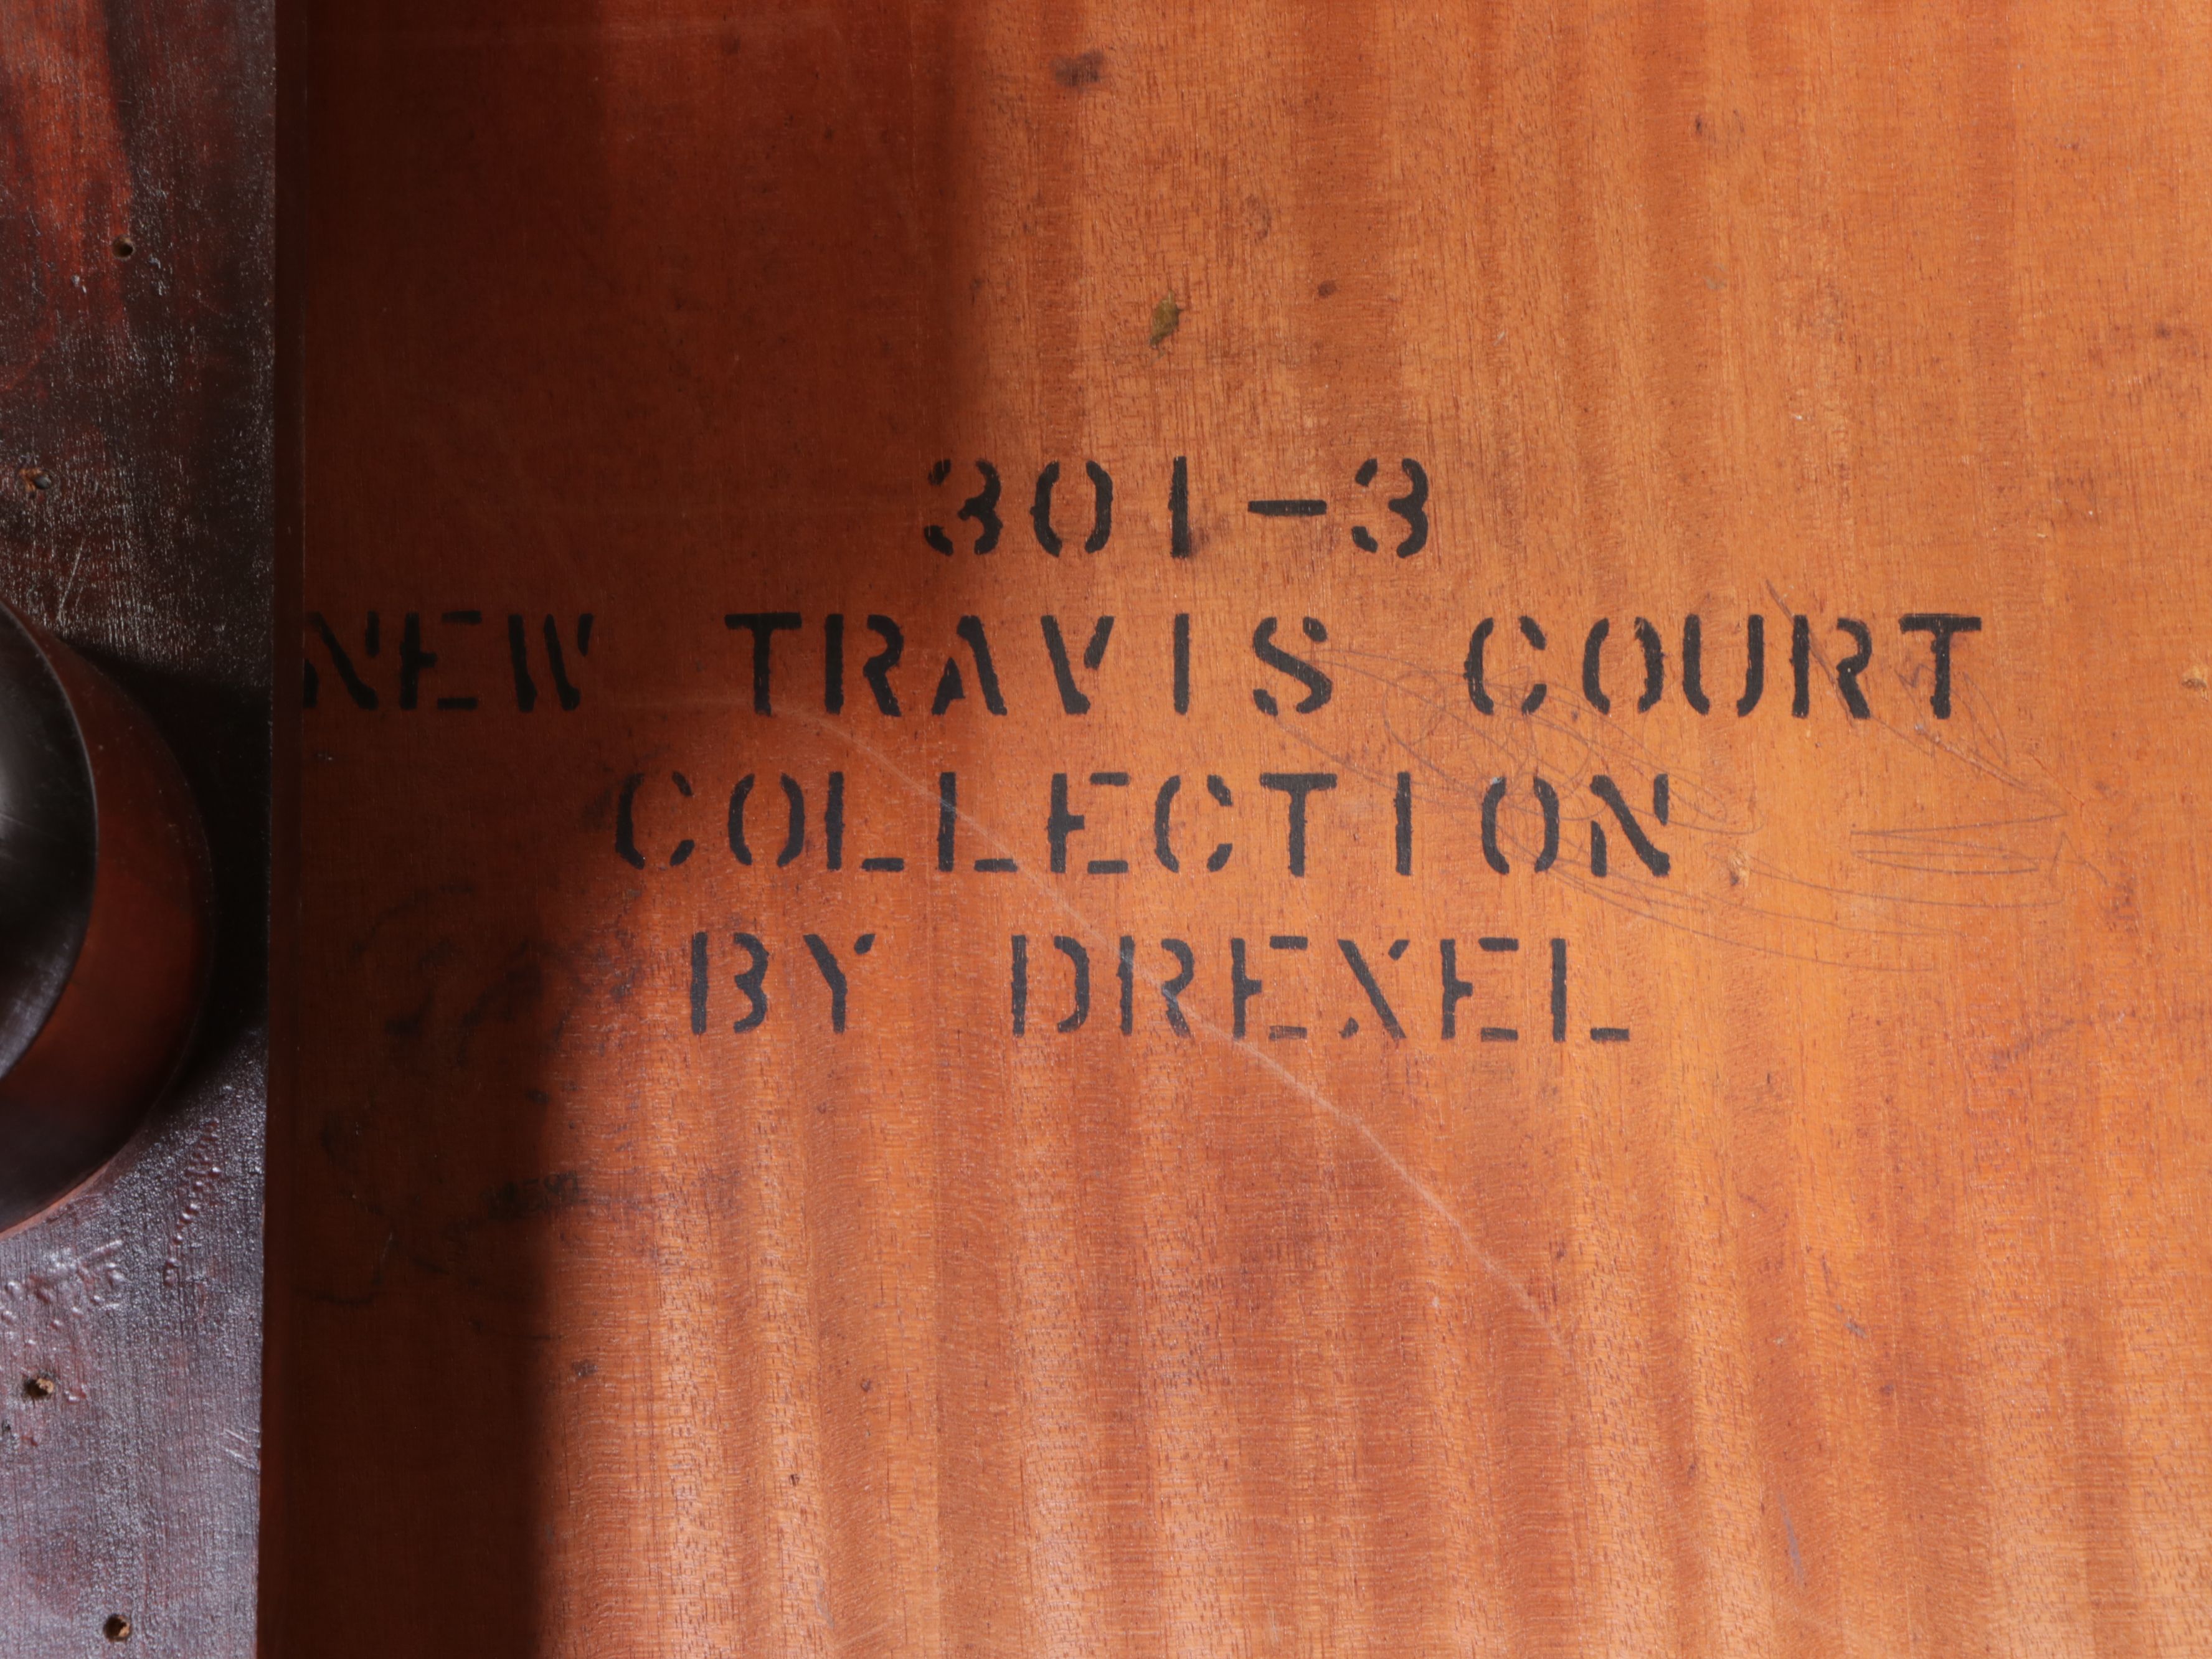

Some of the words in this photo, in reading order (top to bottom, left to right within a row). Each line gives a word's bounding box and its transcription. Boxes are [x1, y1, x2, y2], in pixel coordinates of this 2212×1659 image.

[924, 456, 1429, 559] 301-3
[304, 610, 594, 712] NEW
[725, 612, 1332, 716] TRAVIS
[1464, 613, 1982, 719] COURT
[617, 772, 1671, 877] COLLECTION
[690, 932, 876, 1035] BY
[1010, 935, 1630, 1042] DREXEL
